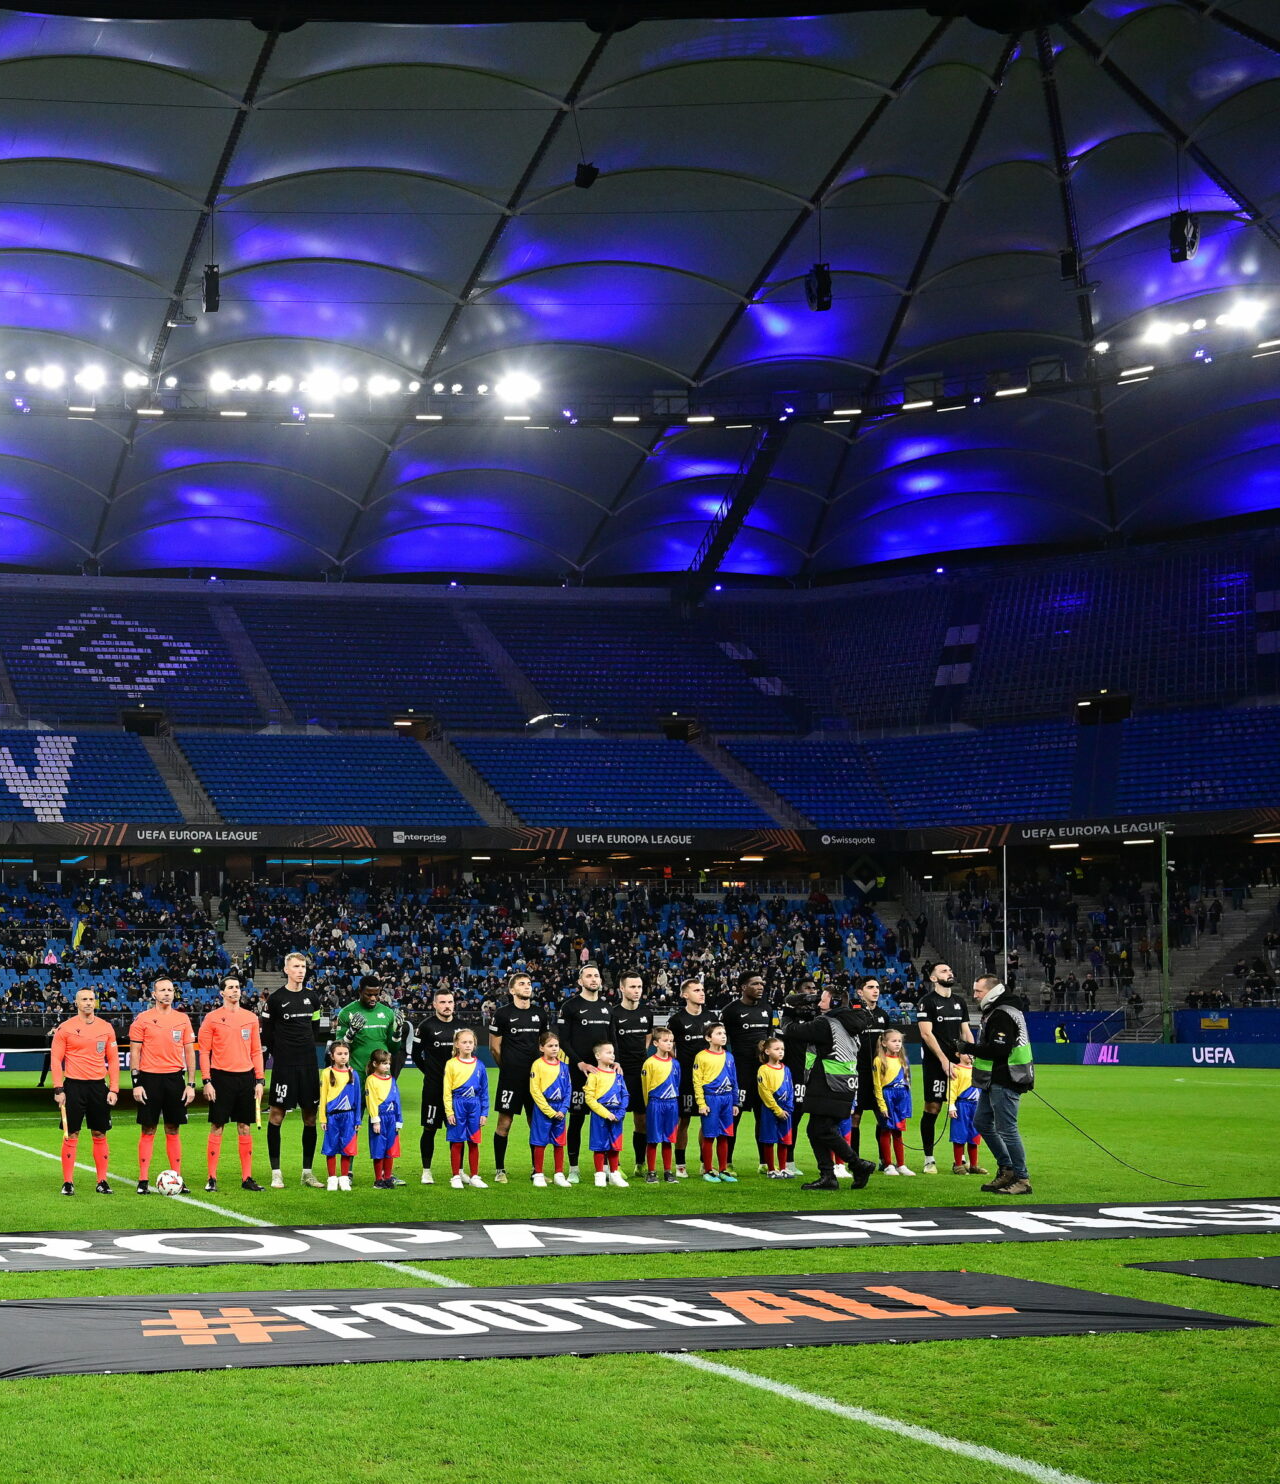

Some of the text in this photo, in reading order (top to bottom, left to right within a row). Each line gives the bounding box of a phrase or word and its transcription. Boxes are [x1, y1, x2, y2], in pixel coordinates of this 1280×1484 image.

[136, 830, 258, 841] UEFA EUROPA LEAGUE
[1021, 828, 1056, 839] UEFA
[1059, 825, 1111, 837] EUROPA
[576, 834, 692, 845] UEFA EUROPA LEAGUE
[830, 835, 876, 846] Swissquote
[1098, 1045, 1120, 1063] ALL
[1191, 1047, 1236, 1064] UEFA
[275, 1083, 288, 1097] 43
[794, 1084, 807, 1098] 30
[932, 1079, 946, 1093] 26
[501, 1089, 514, 1103] 27
[572, 1091, 585, 1104] 23
[683, 1094, 693, 1107] 18
[428, 1104, 437, 1119] 11
[139, 1285, 1022, 1346] #FOOTBALL
